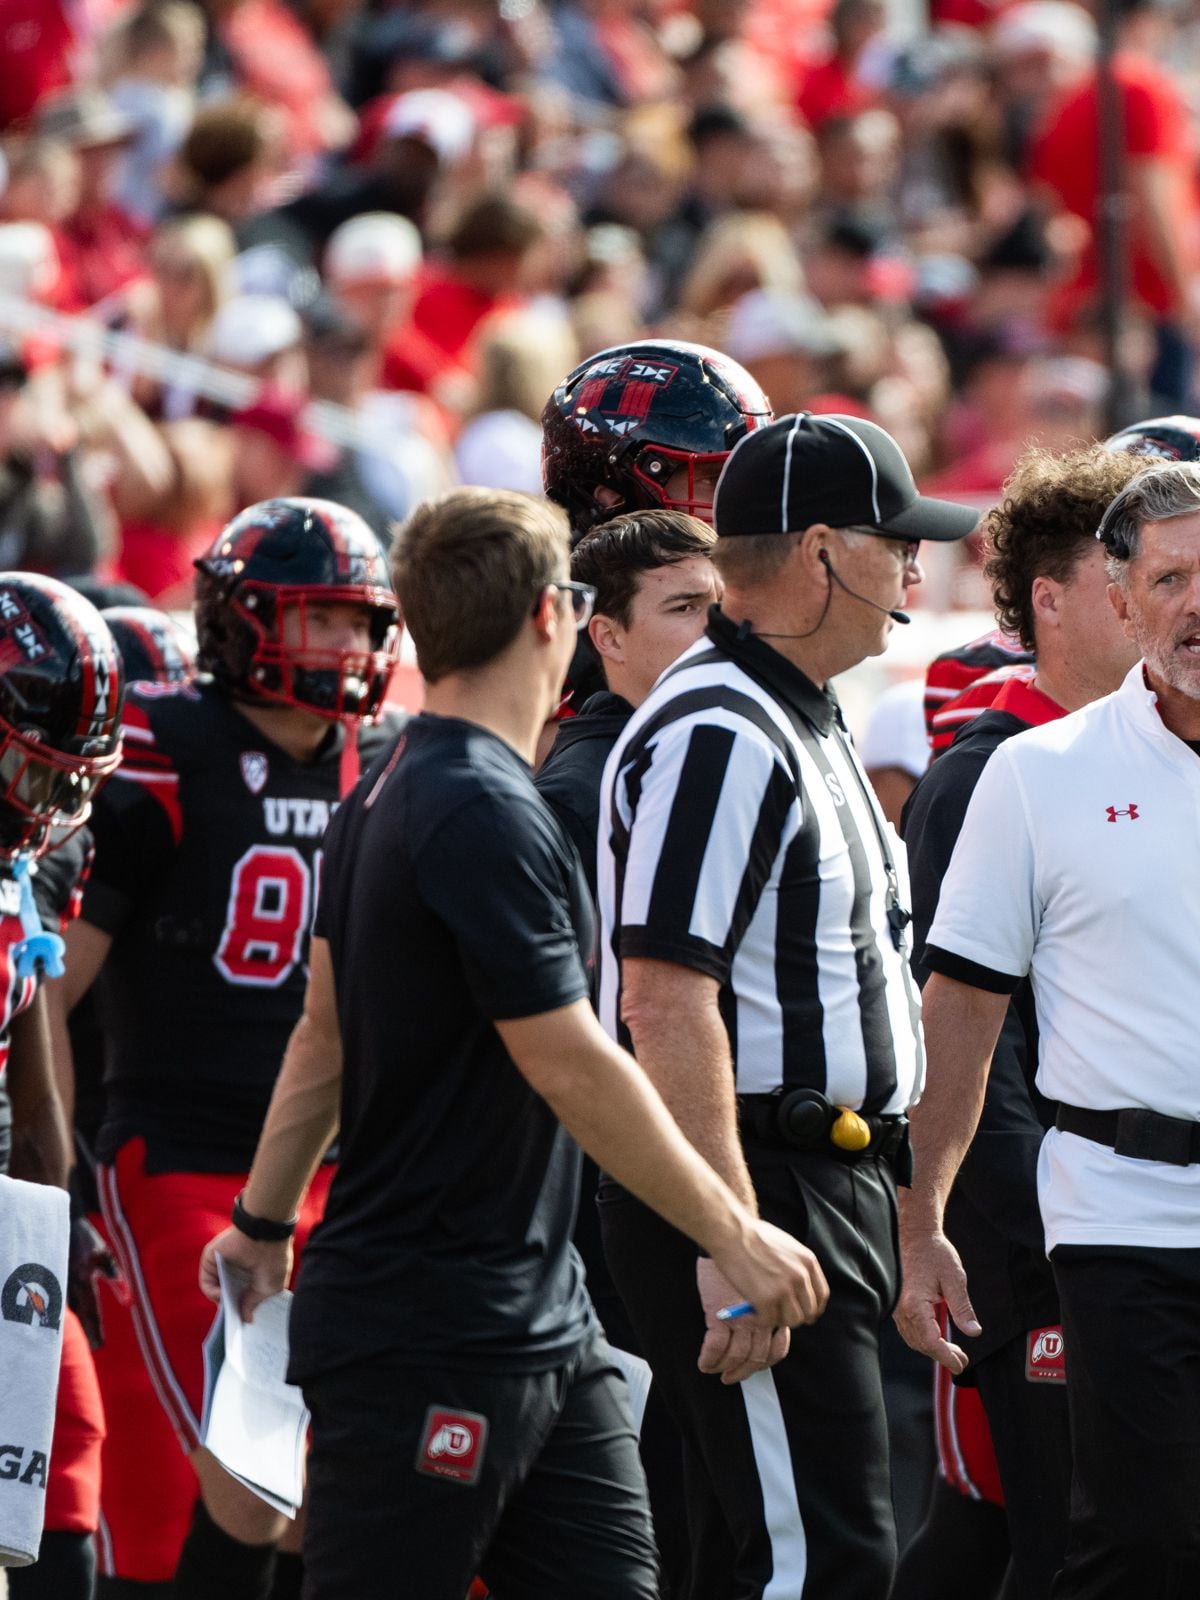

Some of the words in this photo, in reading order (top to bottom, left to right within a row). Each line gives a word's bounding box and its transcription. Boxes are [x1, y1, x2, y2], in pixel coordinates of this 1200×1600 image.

[825, 772, 846, 807] S
[263, 797, 342, 837] UTA
[213, 843, 325, 988] 8
[1044, 1337, 1060, 1354] U
